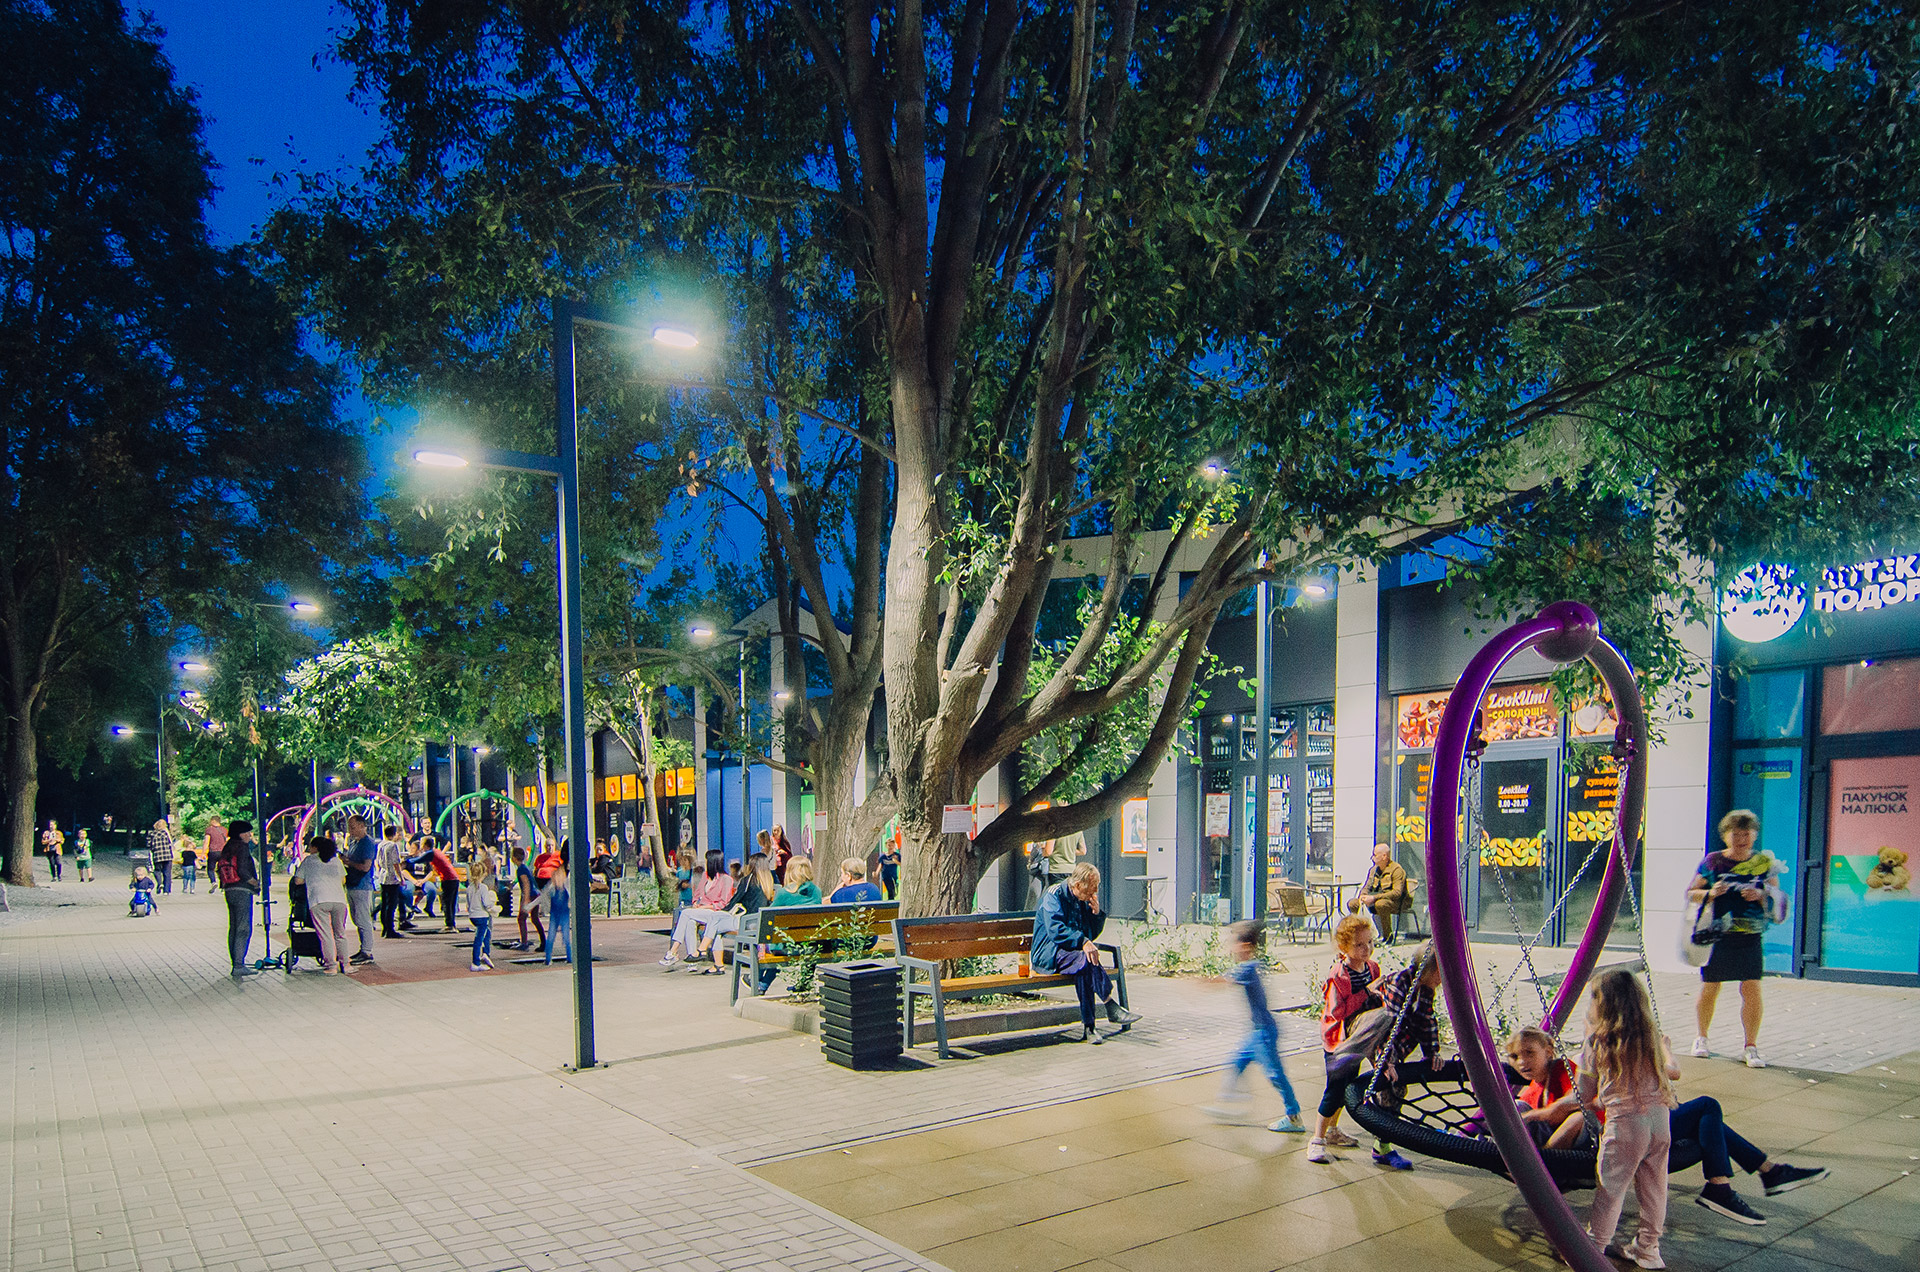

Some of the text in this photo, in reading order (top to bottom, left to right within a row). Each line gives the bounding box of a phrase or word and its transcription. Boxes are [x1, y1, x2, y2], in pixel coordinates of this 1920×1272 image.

[1586, 775, 1618, 787] сухофру
[1842, 791, 1908, 803] ПАКУНОК
[1841, 803, 1908, 815] МАЛЮКА
